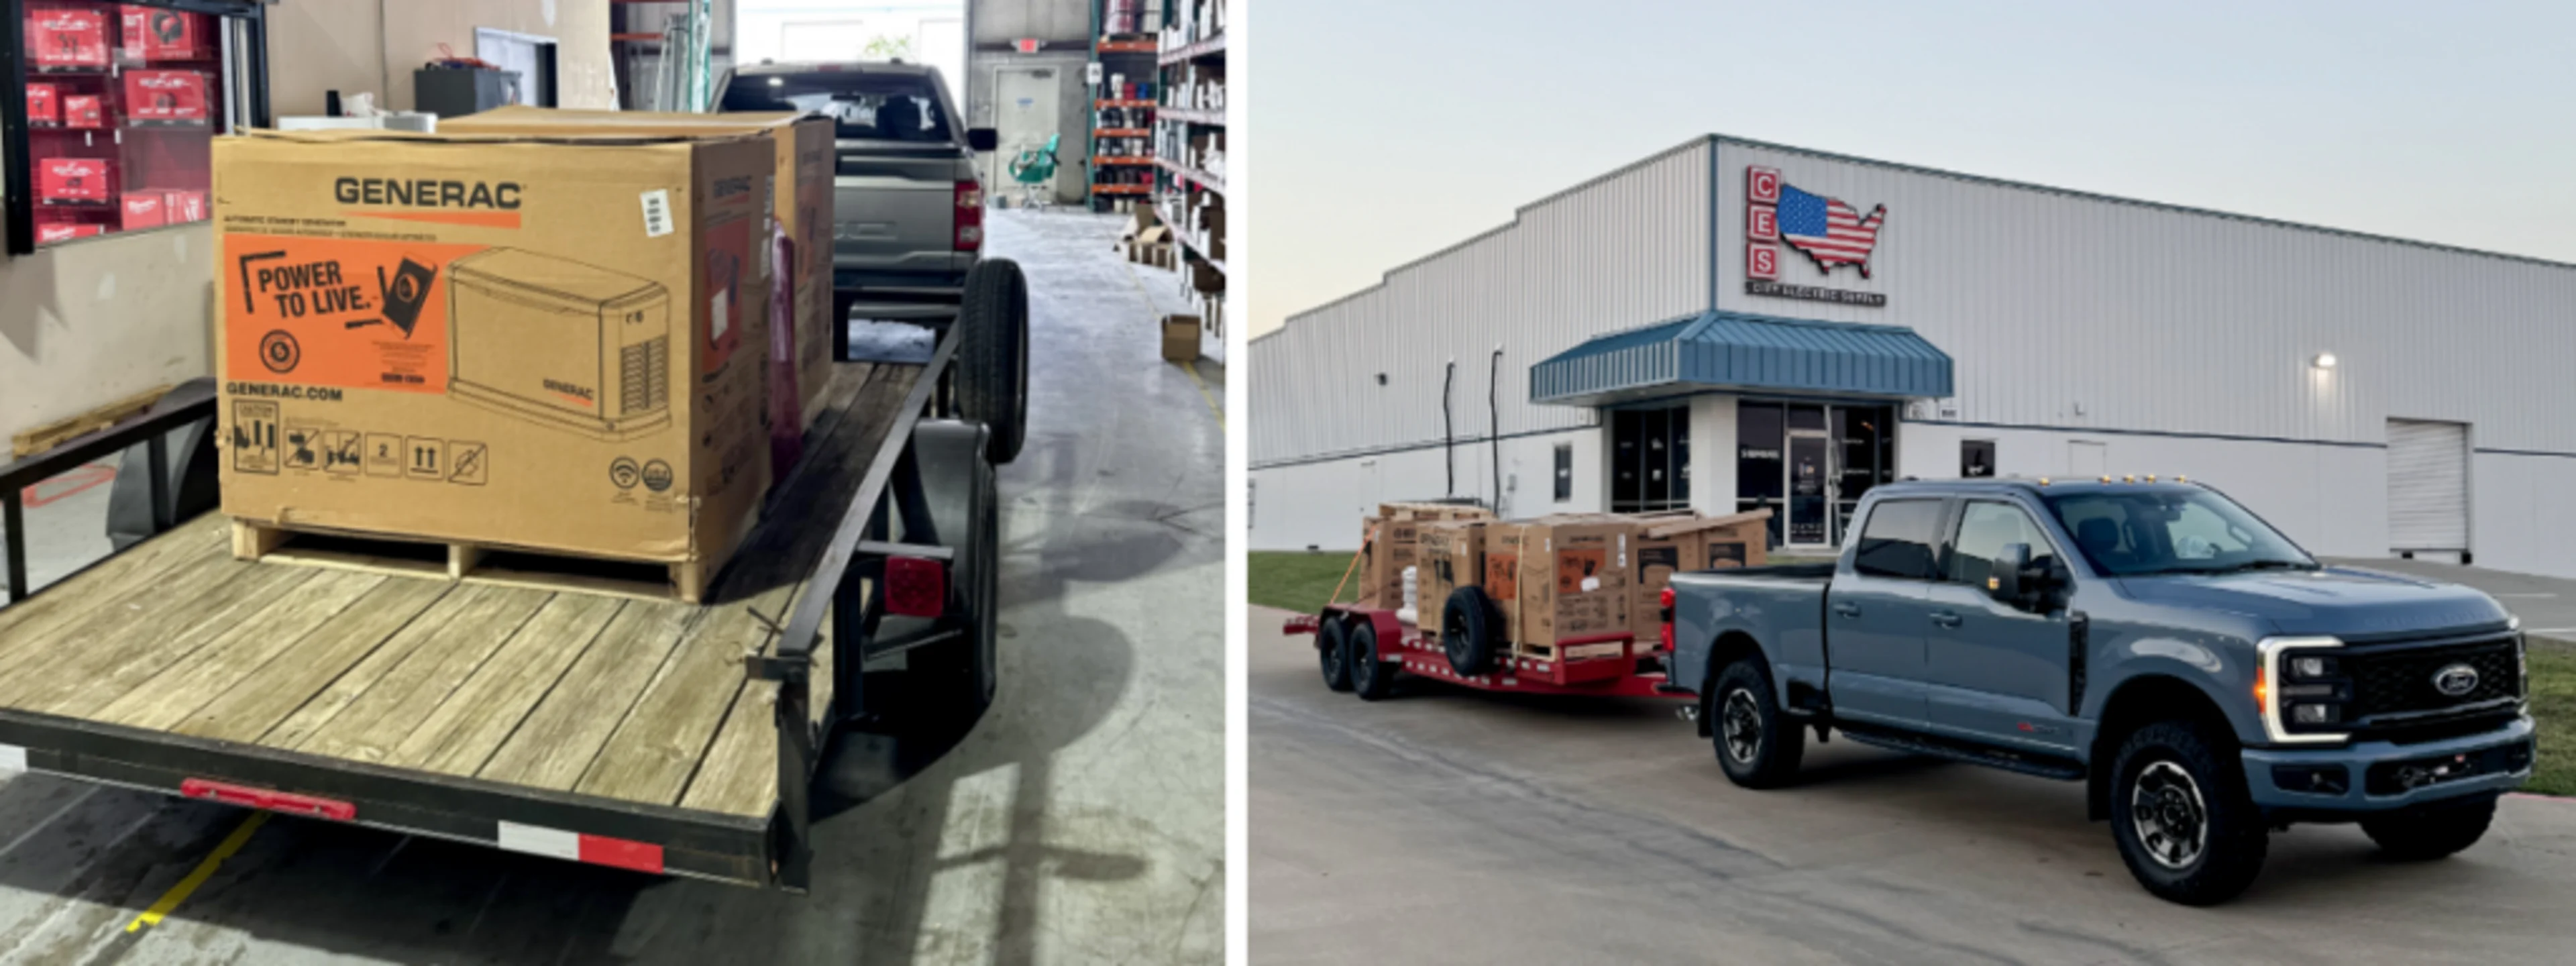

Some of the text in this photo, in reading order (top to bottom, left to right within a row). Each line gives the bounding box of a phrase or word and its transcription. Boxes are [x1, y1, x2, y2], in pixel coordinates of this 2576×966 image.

[335, 176, 522, 209] GENERAC
[258, 260, 343, 293] POWER
[274, 285, 372, 319] TO LIVE.
[226, 382, 343, 401] GENERAC.COM
[543, 378, 594, 401] GENERAC
[379, 442, 388, 458] 2
